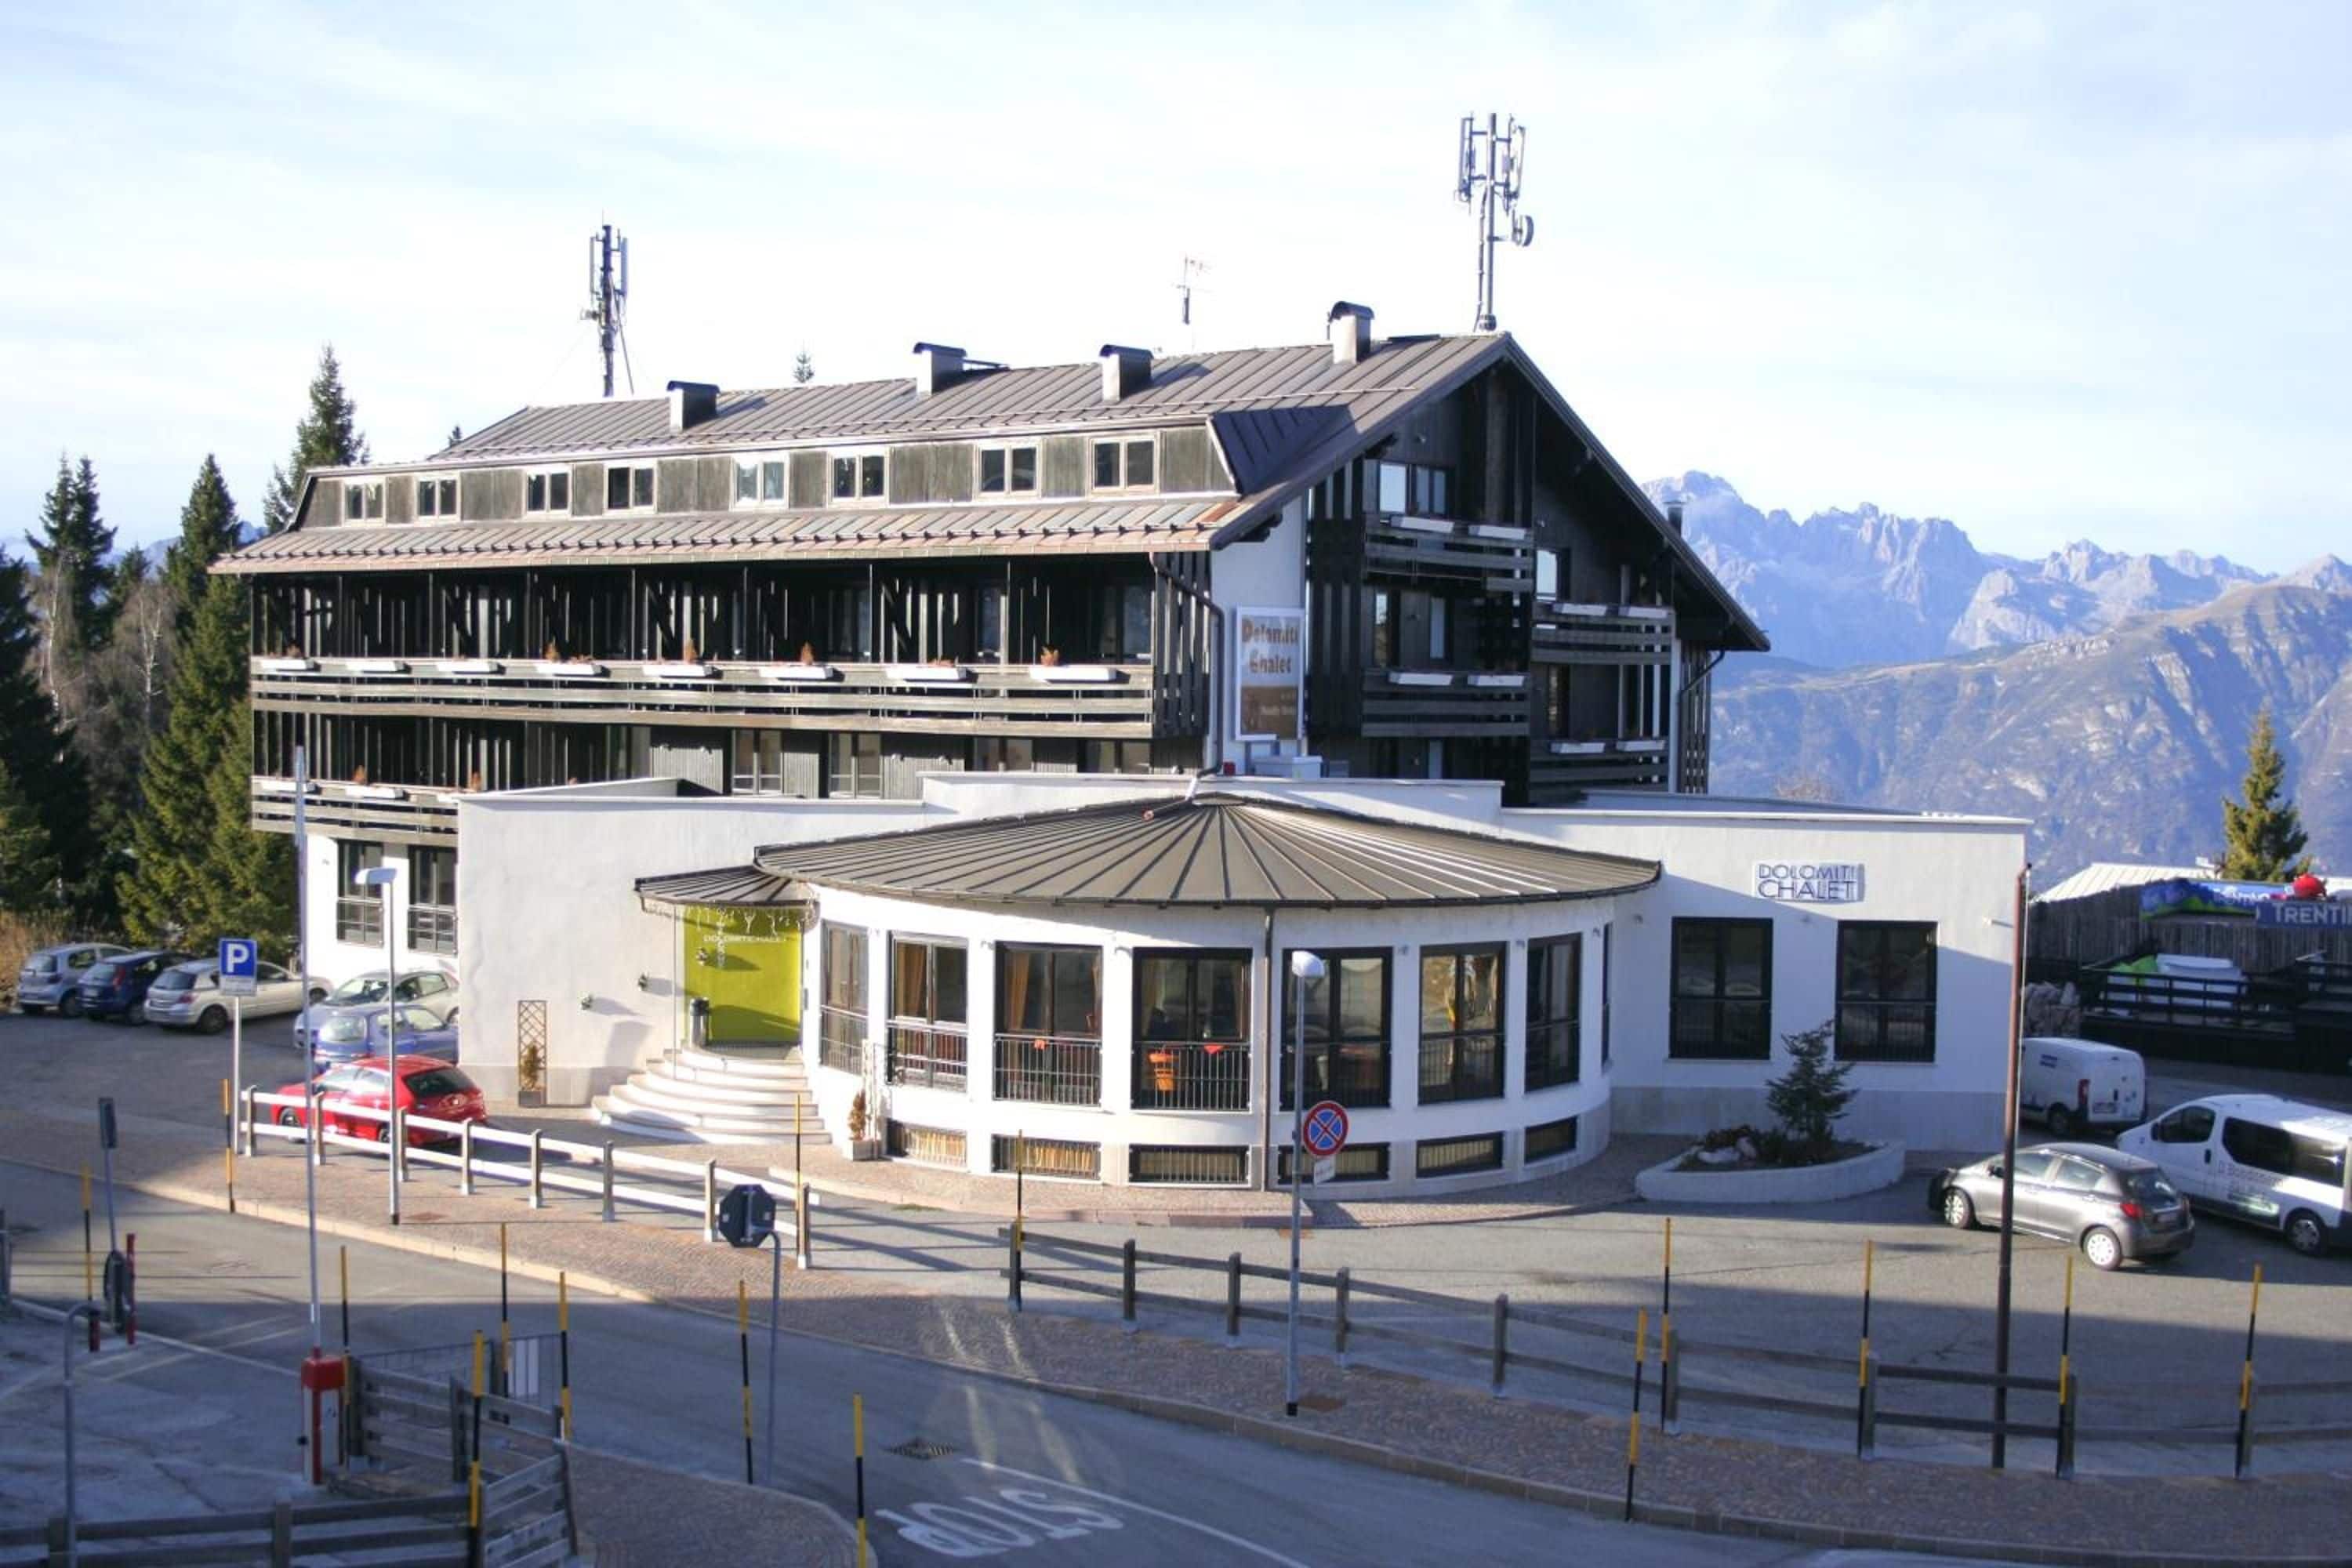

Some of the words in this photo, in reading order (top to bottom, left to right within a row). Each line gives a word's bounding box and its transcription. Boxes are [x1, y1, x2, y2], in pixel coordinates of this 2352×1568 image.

[1758, 863, 1855, 880] DOLOMITI
[1758, 880, 1857, 899] CHALET
[226, 942, 249, 973] P
[874, 1488, 1124, 1558] STOP
